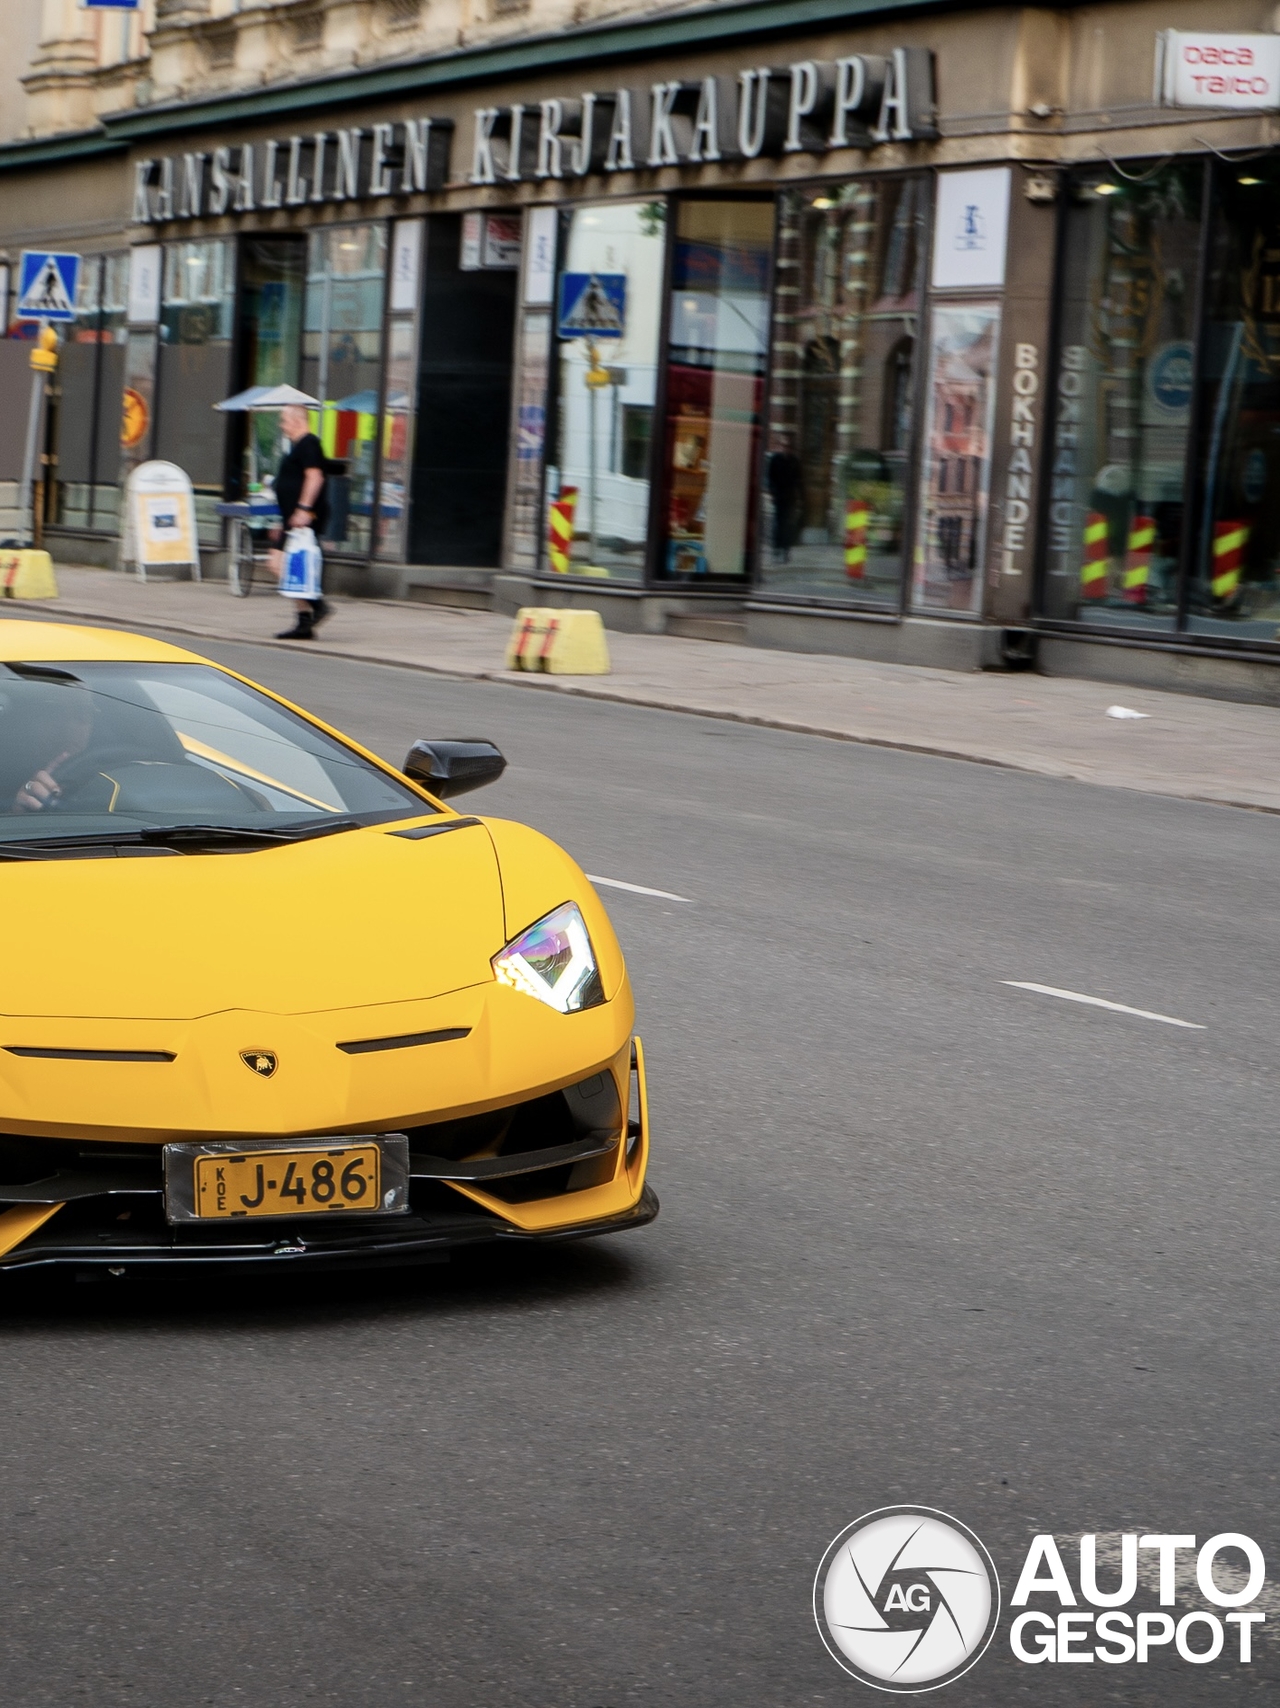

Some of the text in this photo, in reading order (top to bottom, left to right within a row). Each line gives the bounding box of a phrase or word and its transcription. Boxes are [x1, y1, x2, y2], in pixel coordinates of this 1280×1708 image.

[132, 48, 913, 223] KANSALLINEN KIRJAKAUPPA
[1002, 343, 1039, 576] BOKHANDEL
[216, 1167, 227, 1211] KOE
[240, 1157, 367, 1208] J-486
